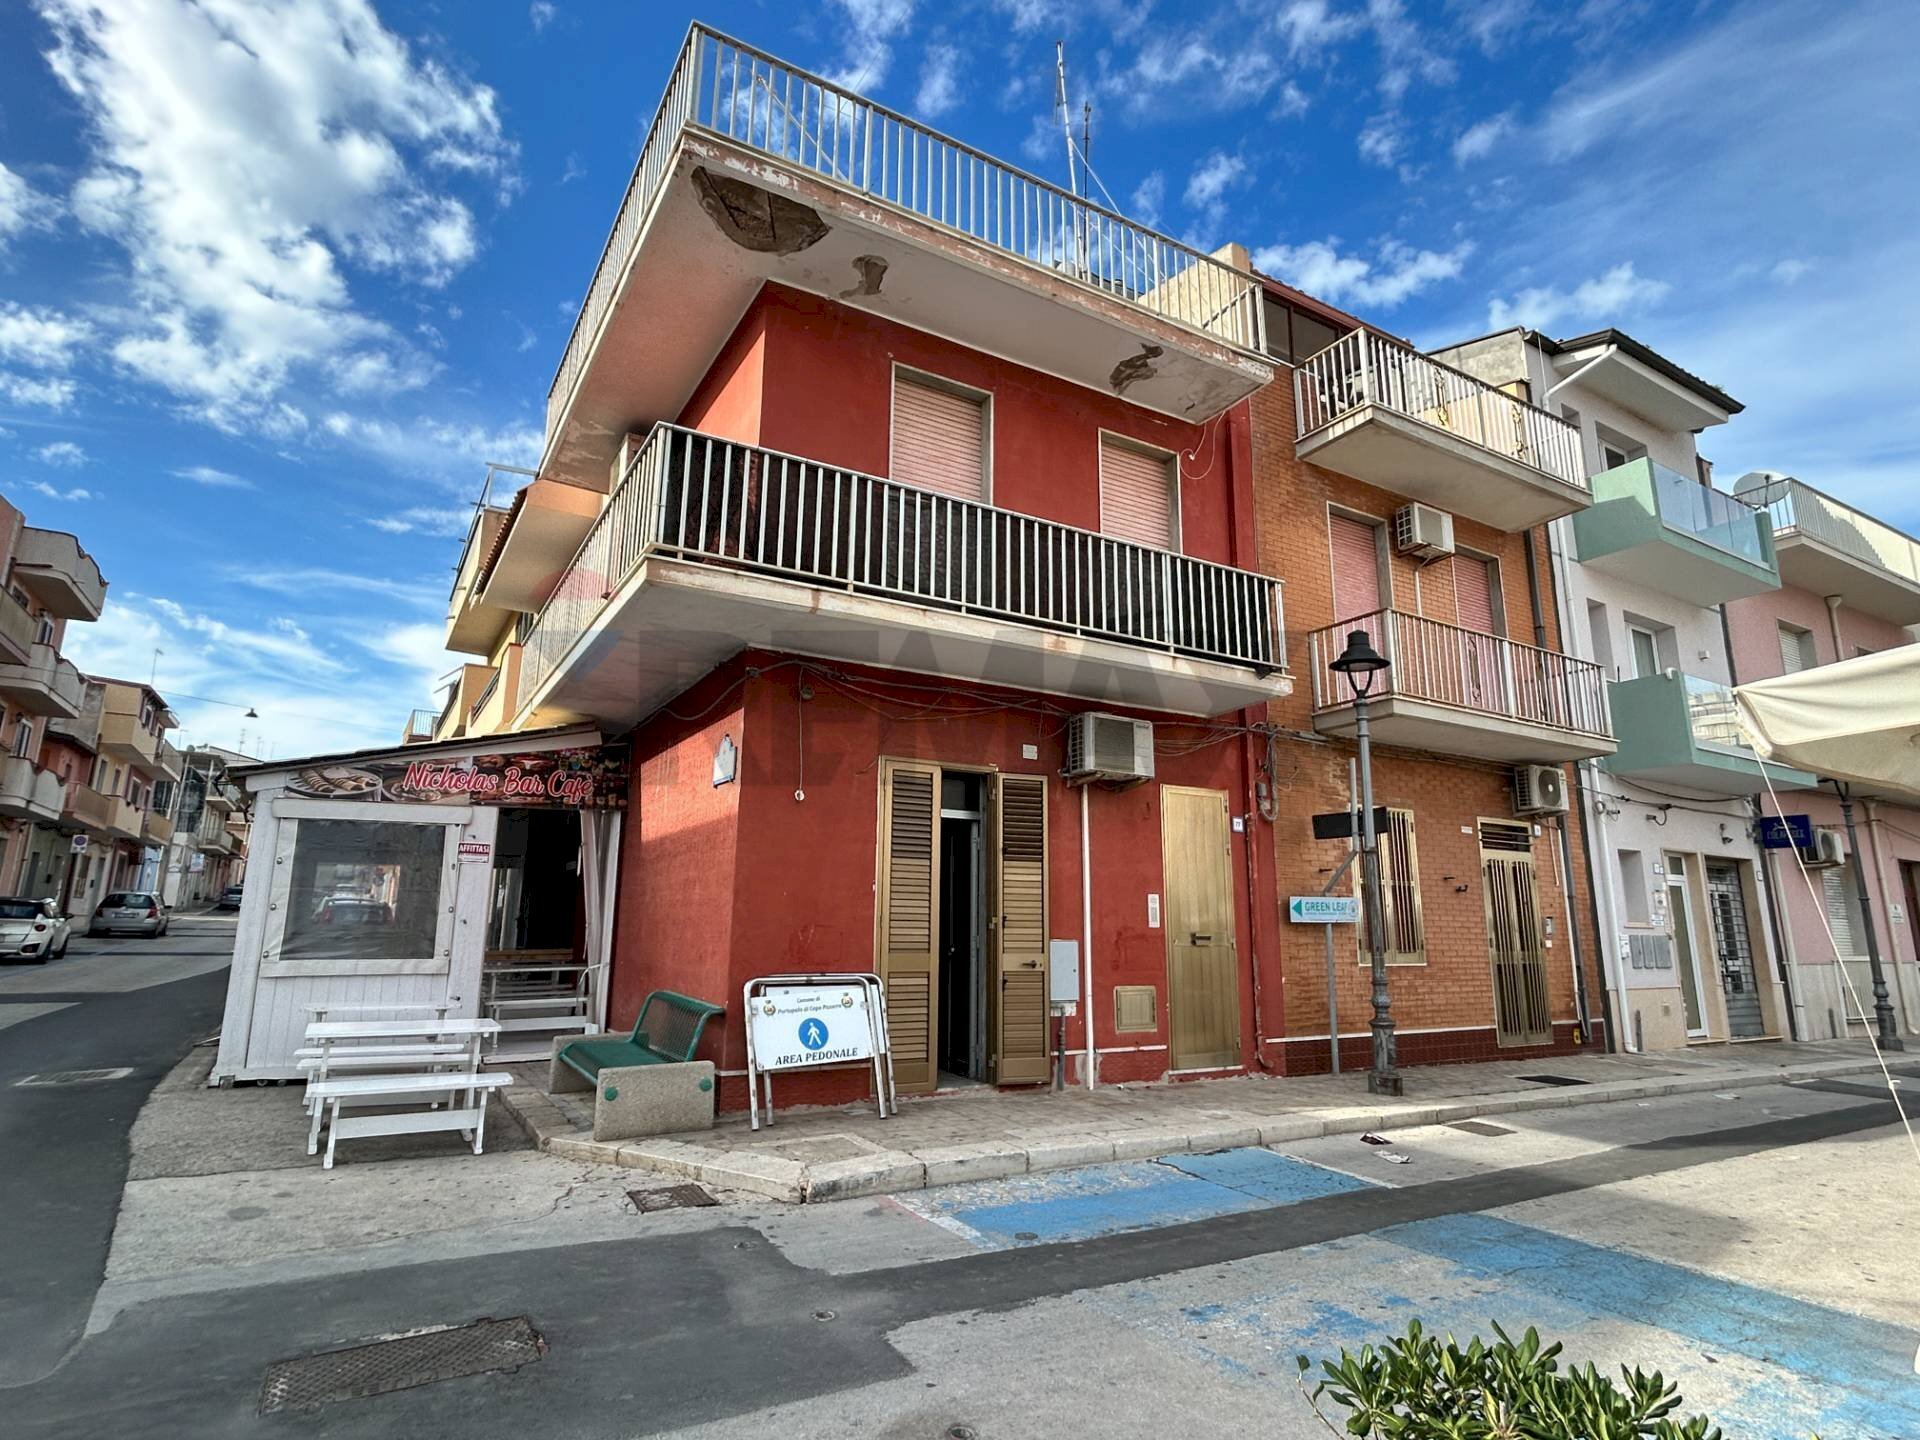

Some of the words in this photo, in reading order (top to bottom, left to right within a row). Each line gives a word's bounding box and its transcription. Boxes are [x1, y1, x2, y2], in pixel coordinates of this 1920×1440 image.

[402, 762, 499, 791] Nicholas
[503, 766, 544, 794] Bar
[458, 844, 490, 853] AFFITTASI
[1304, 901, 1330, 912] GREEN
[1332, 901, 1348, 912] LEAF
[775, 1054, 803, 1066] AREA
[805, 1047, 858, 1062] PEDONALE
